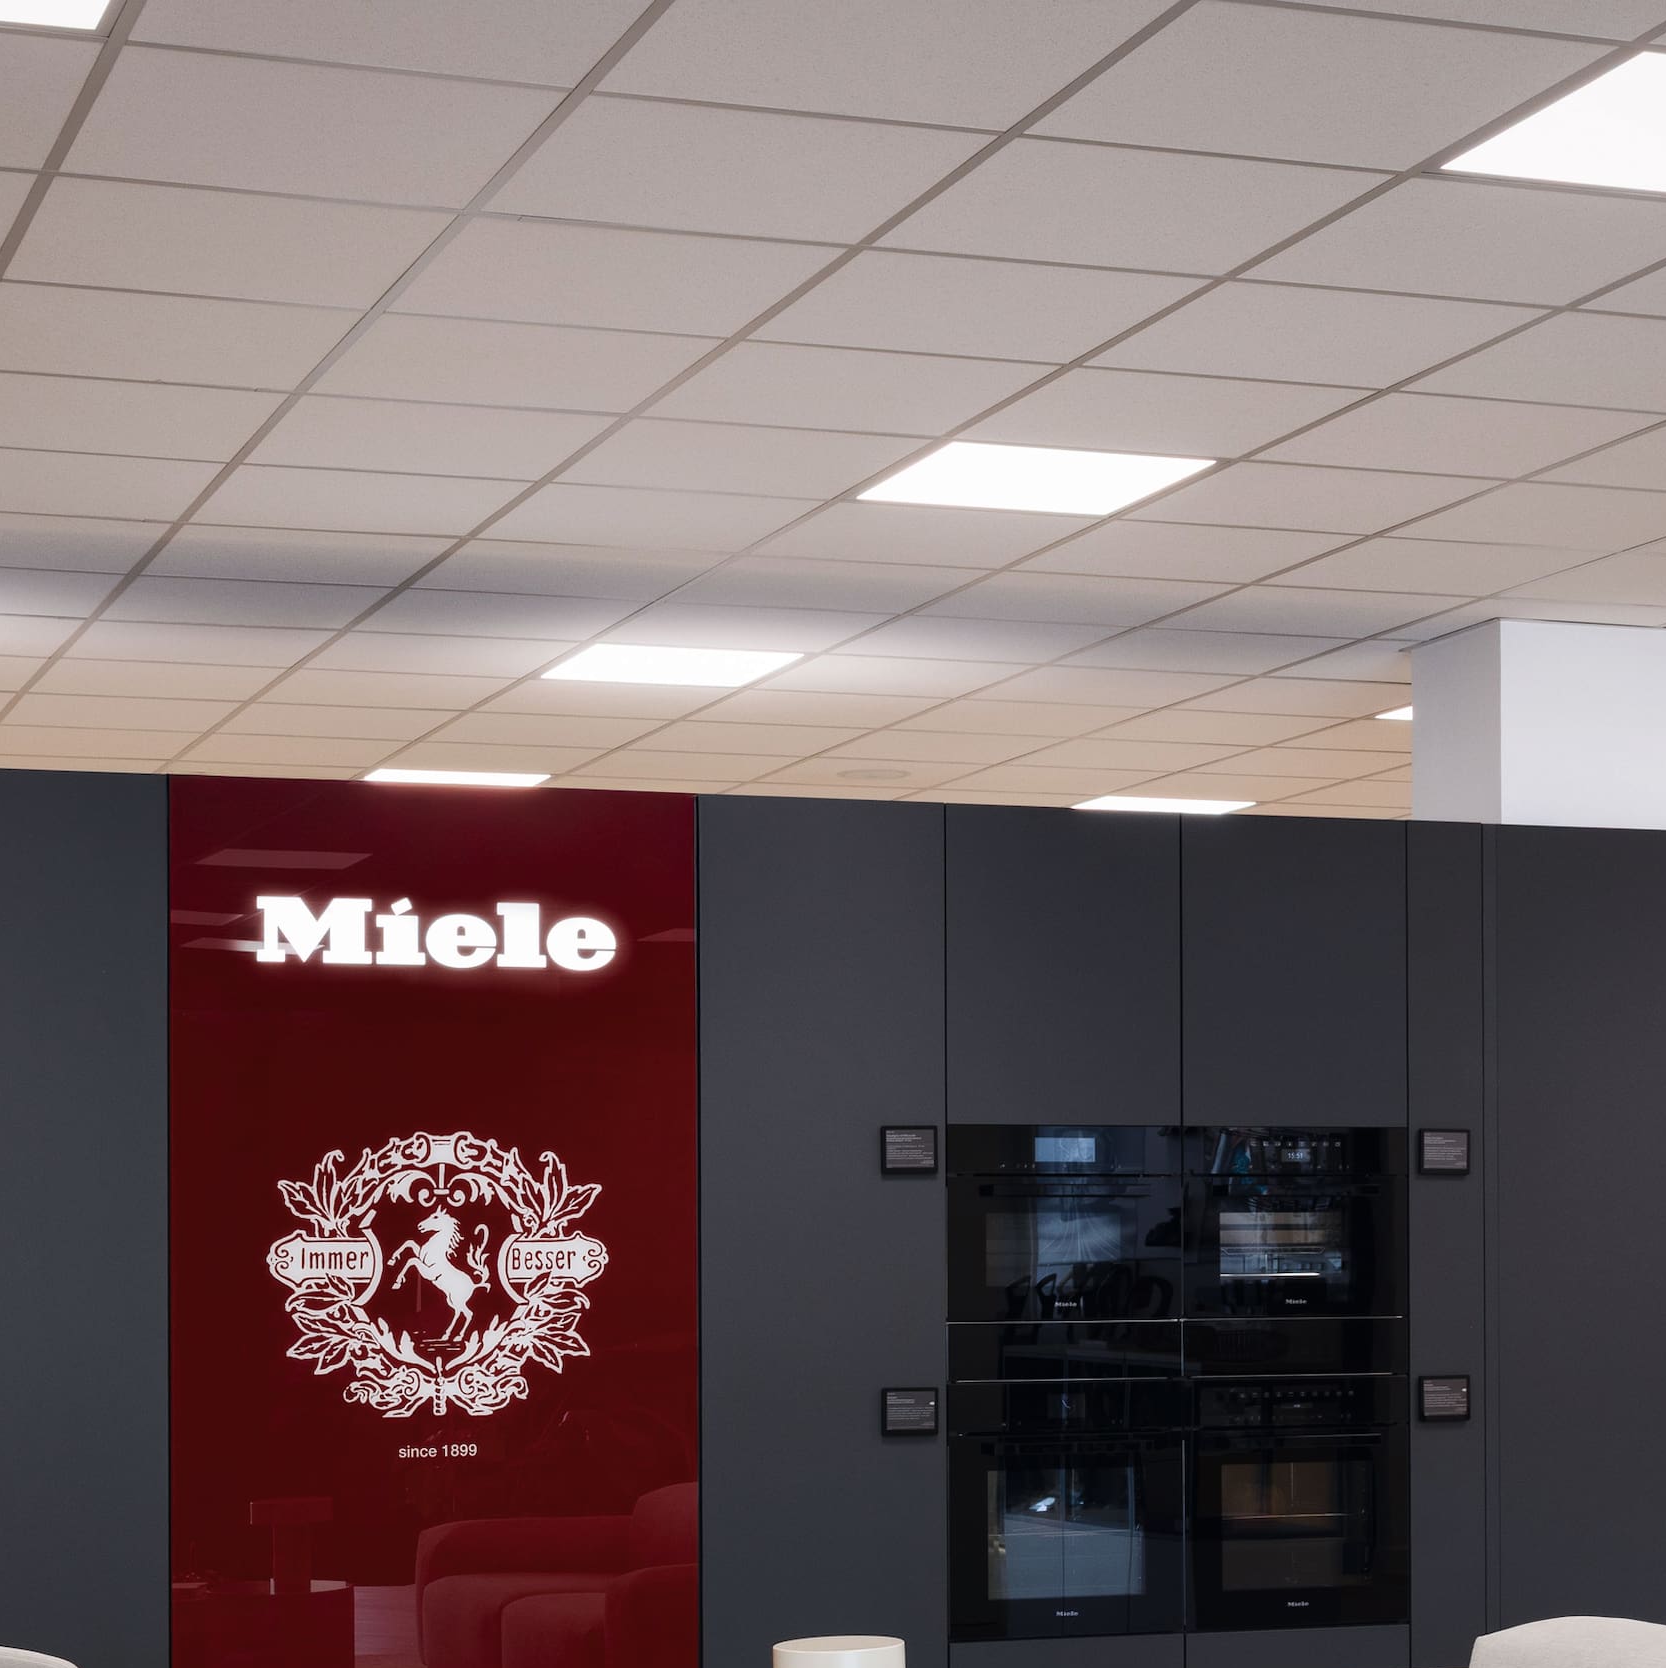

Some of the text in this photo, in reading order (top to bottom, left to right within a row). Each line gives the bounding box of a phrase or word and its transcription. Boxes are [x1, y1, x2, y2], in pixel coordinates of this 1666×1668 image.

[256, 895, 617, 971] Miele
[300, 1247, 369, 1271] Immer
[511, 1247, 576, 1271] Besser
[398, 1443, 478, 1458] since 1899
